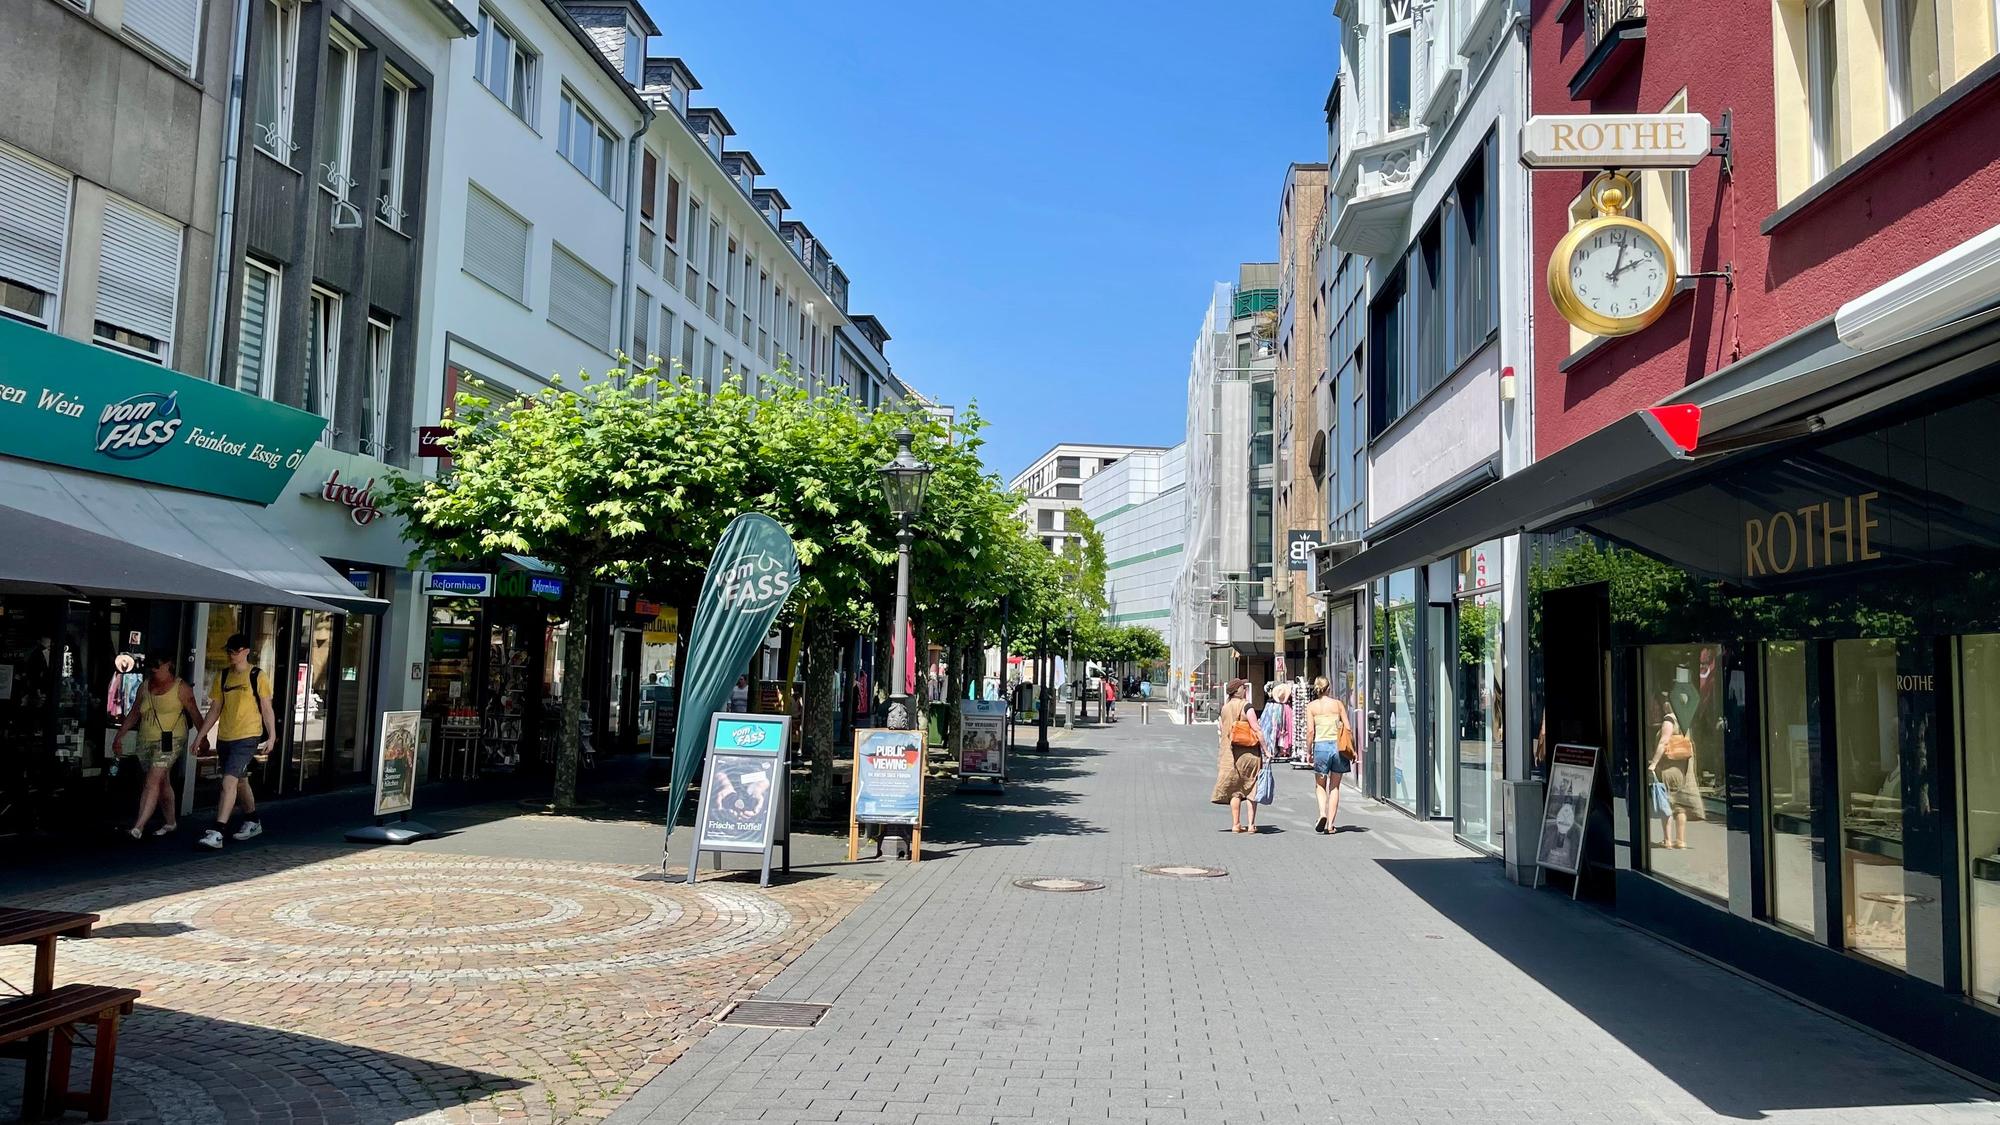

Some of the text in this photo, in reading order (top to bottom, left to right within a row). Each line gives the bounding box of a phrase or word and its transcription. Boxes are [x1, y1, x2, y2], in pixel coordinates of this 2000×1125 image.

[1551, 122, 1687, 151] ROTHE
[1594, 236, 1602, 248] 11
[1633, 237, 1637, 249] 1
[1579, 249, 1590, 260] 10
[1643, 250, 1653, 262] 2
[1574, 266, 1582, 278] 9
[1648, 268, 1657, 280] 3
[1579, 284, 1587, 296] 8
[1643, 286, 1651, 298] 4
[1592, 297, 1600, 309] 7
[1610, 303, 1619, 314] 6
[1629, 298, 1638, 309] 5
[38, 388, 84, 418] Wein
[102, 402, 156, 423] vom
[99, 419, 182, 450] FASS
[184, 426, 247, 456] Feinkost
[248, 443, 283, 469] Essig
[1746, 491, 1881, 577] ROTHE
[715, 562, 753, 587] vom
[432, 579, 481, 592] Reformhaus
[532, 579, 561, 596] Reformhaus
[725, 571, 790, 611] FASS
[1896, 674, 1934, 691] ROTHE
[736, 731, 766, 747] FASS
[876, 745, 906, 757] PUBLIC
[872, 758, 907, 770] VIEWING
